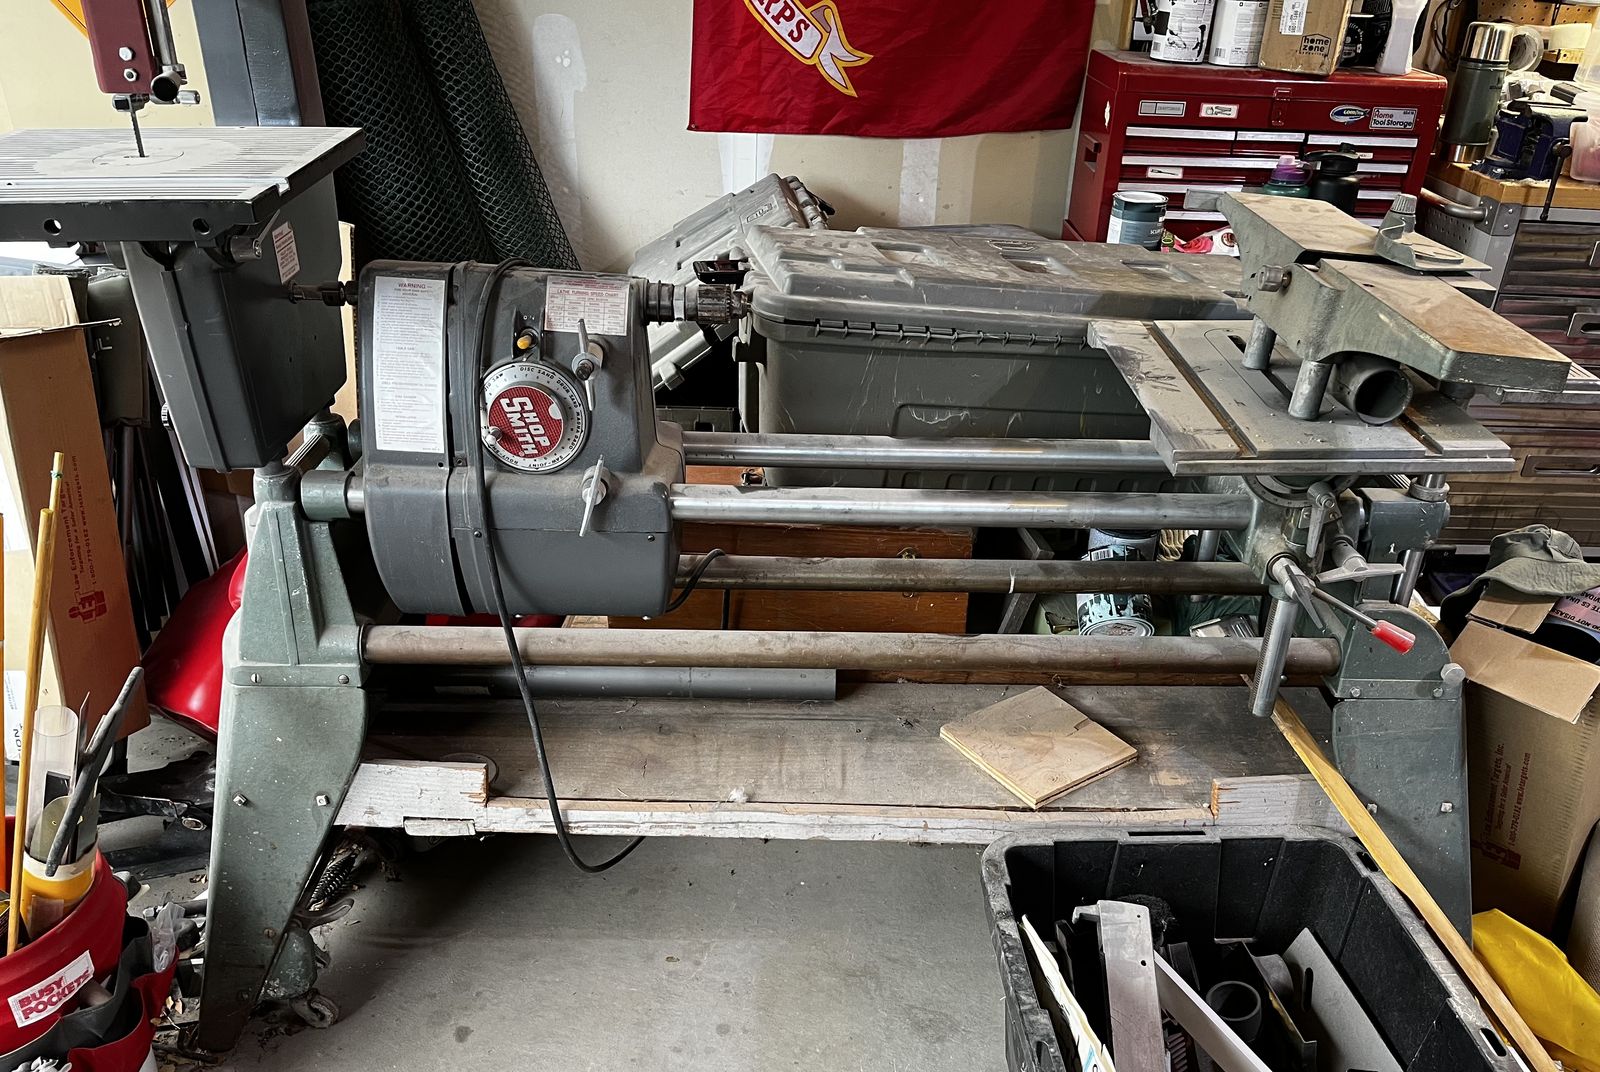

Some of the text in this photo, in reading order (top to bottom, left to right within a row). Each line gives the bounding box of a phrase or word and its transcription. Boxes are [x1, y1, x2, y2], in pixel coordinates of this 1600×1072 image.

[1303, 36, 1330, 46] home
[1302, 45, 1325, 53] zone
[1373, 110, 1394, 119] Home
[1386, 119, 1413, 128] Storage
[538, 369, 555, 380] SAND
[500, 397, 539, 456] SMITH
[1576, 618, 1591, 627] NOT
[18, 975, 65, 1009] BUSY
[21, 968, 91, 1020] POCKETS
